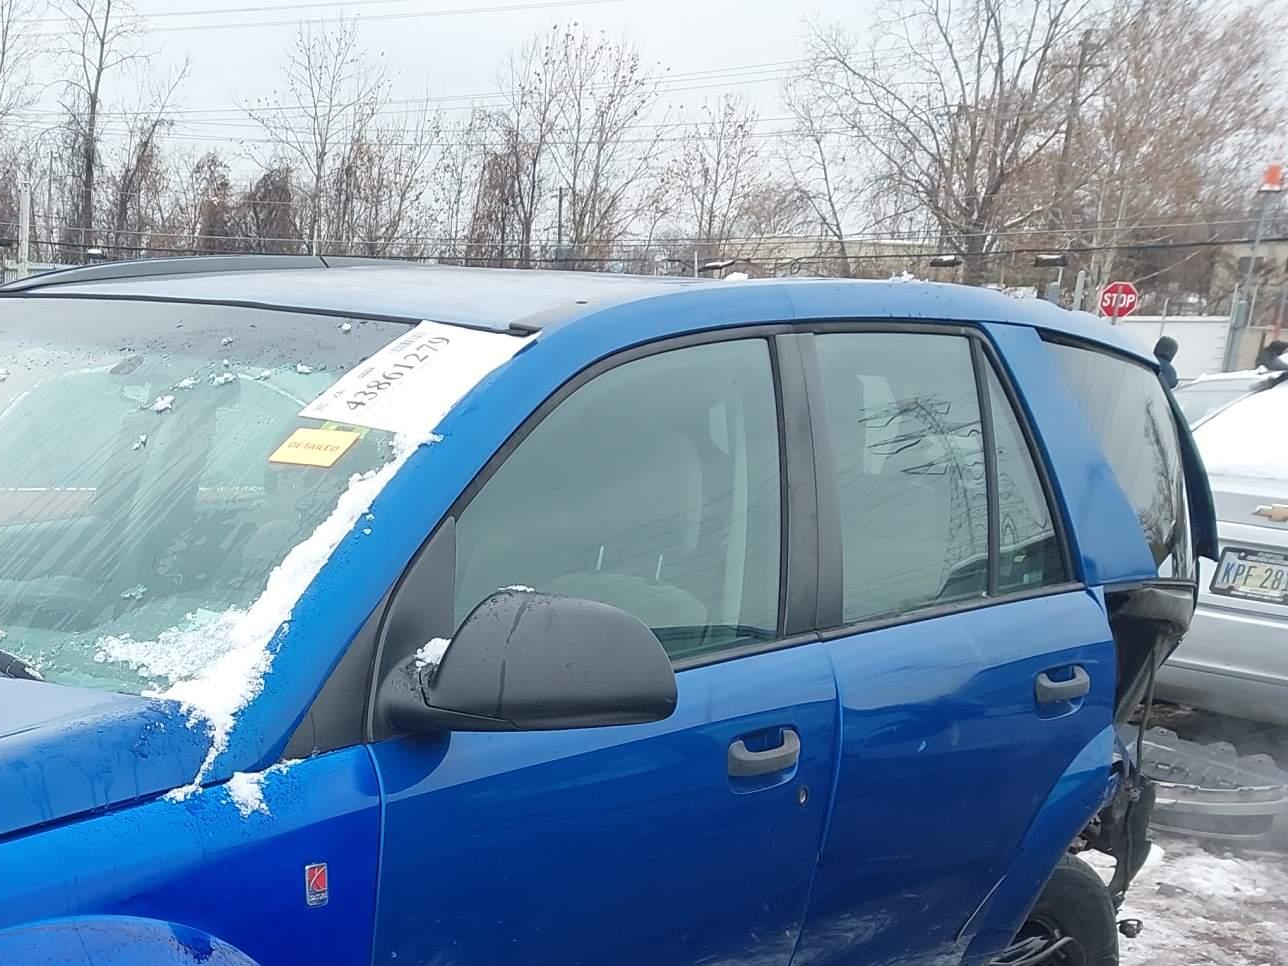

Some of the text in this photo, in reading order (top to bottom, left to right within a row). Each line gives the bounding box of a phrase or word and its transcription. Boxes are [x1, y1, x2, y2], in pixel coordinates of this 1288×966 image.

[1102, 292, 1136, 308] STOP
[346, 335, 451, 411] 43861279
[287, 440, 340, 452] DETAILED
[1221, 562, 1258, 586] KPF
